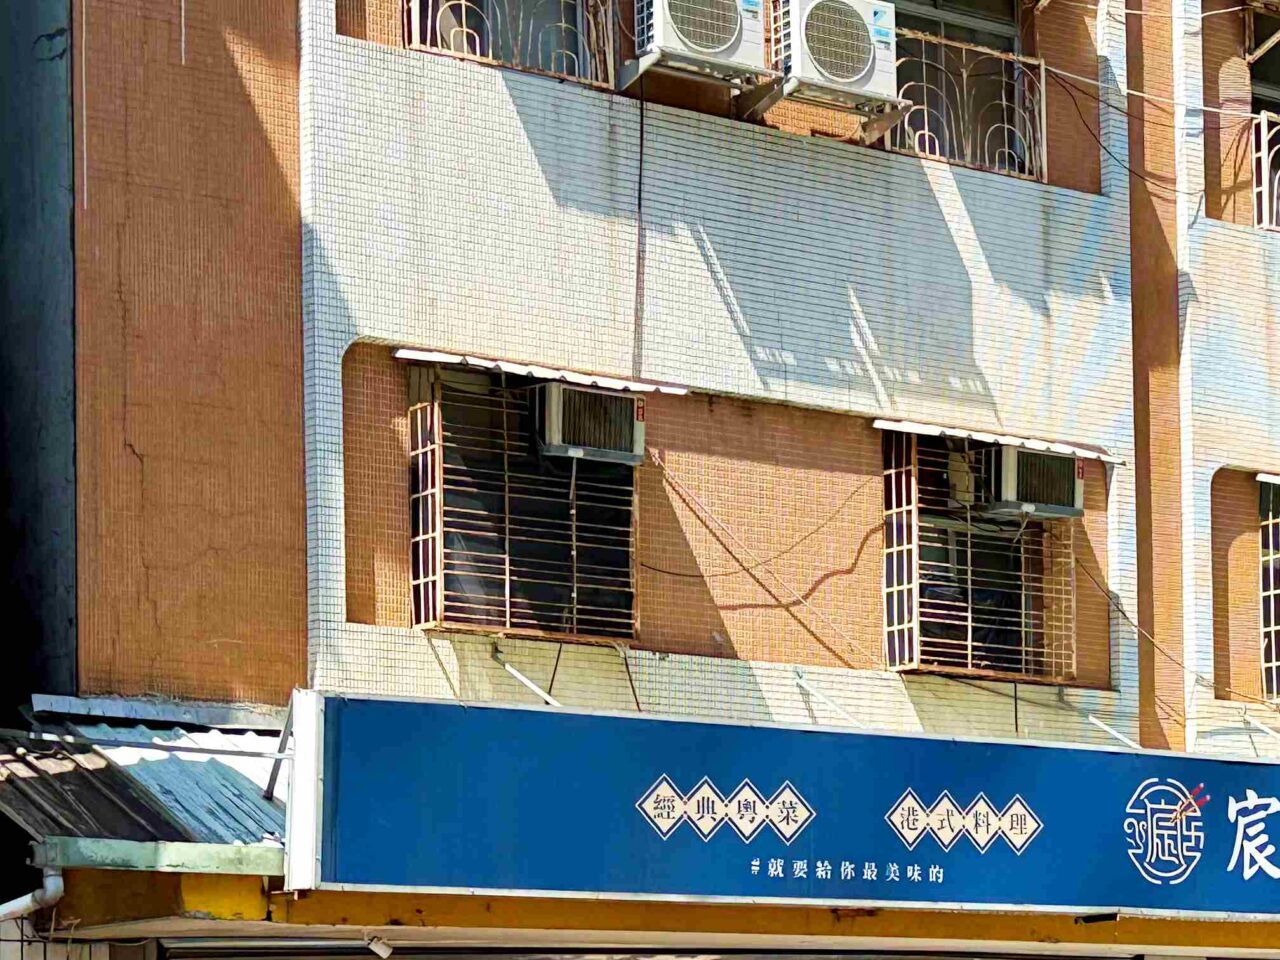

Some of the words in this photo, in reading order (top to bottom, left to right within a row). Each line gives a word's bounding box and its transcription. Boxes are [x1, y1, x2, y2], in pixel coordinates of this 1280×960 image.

[653, 794, 800, 826] 經典粵菜
[901, 806, 1028, 836] 港式料理
